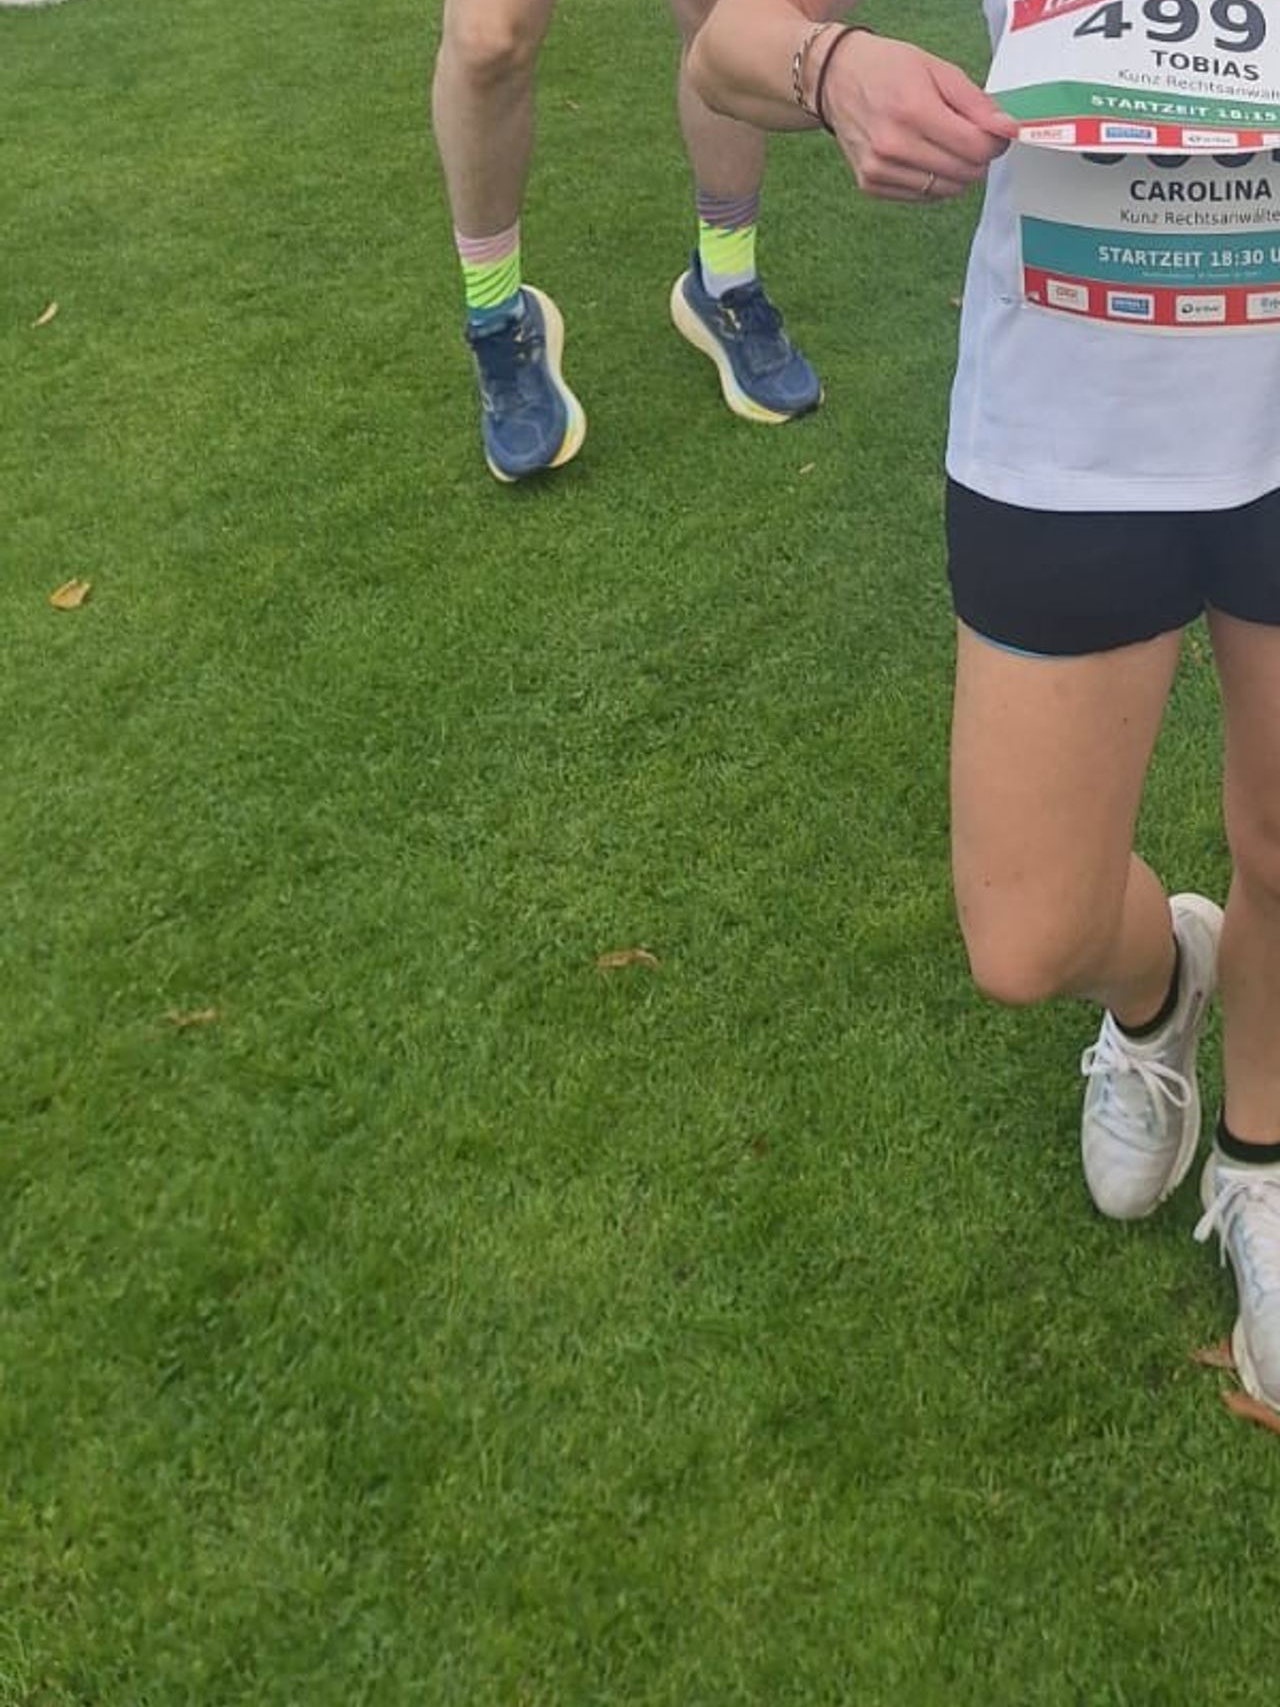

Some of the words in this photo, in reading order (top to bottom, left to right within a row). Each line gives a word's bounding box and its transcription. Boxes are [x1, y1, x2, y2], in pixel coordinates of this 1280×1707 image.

[1117, 68, 1159, 85] Kunz
[1150, 50, 1261, 81] TOBIAS
[1090, 95, 1210, 118] STARTZEIT
[1130, 179, 1273, 202] CAROLINA
[1119, 208, 1158, 225] Kunz
[1098, 246, 1203, 268] STARTZEIT
[1210, 249, 1264, 267] 18:30
